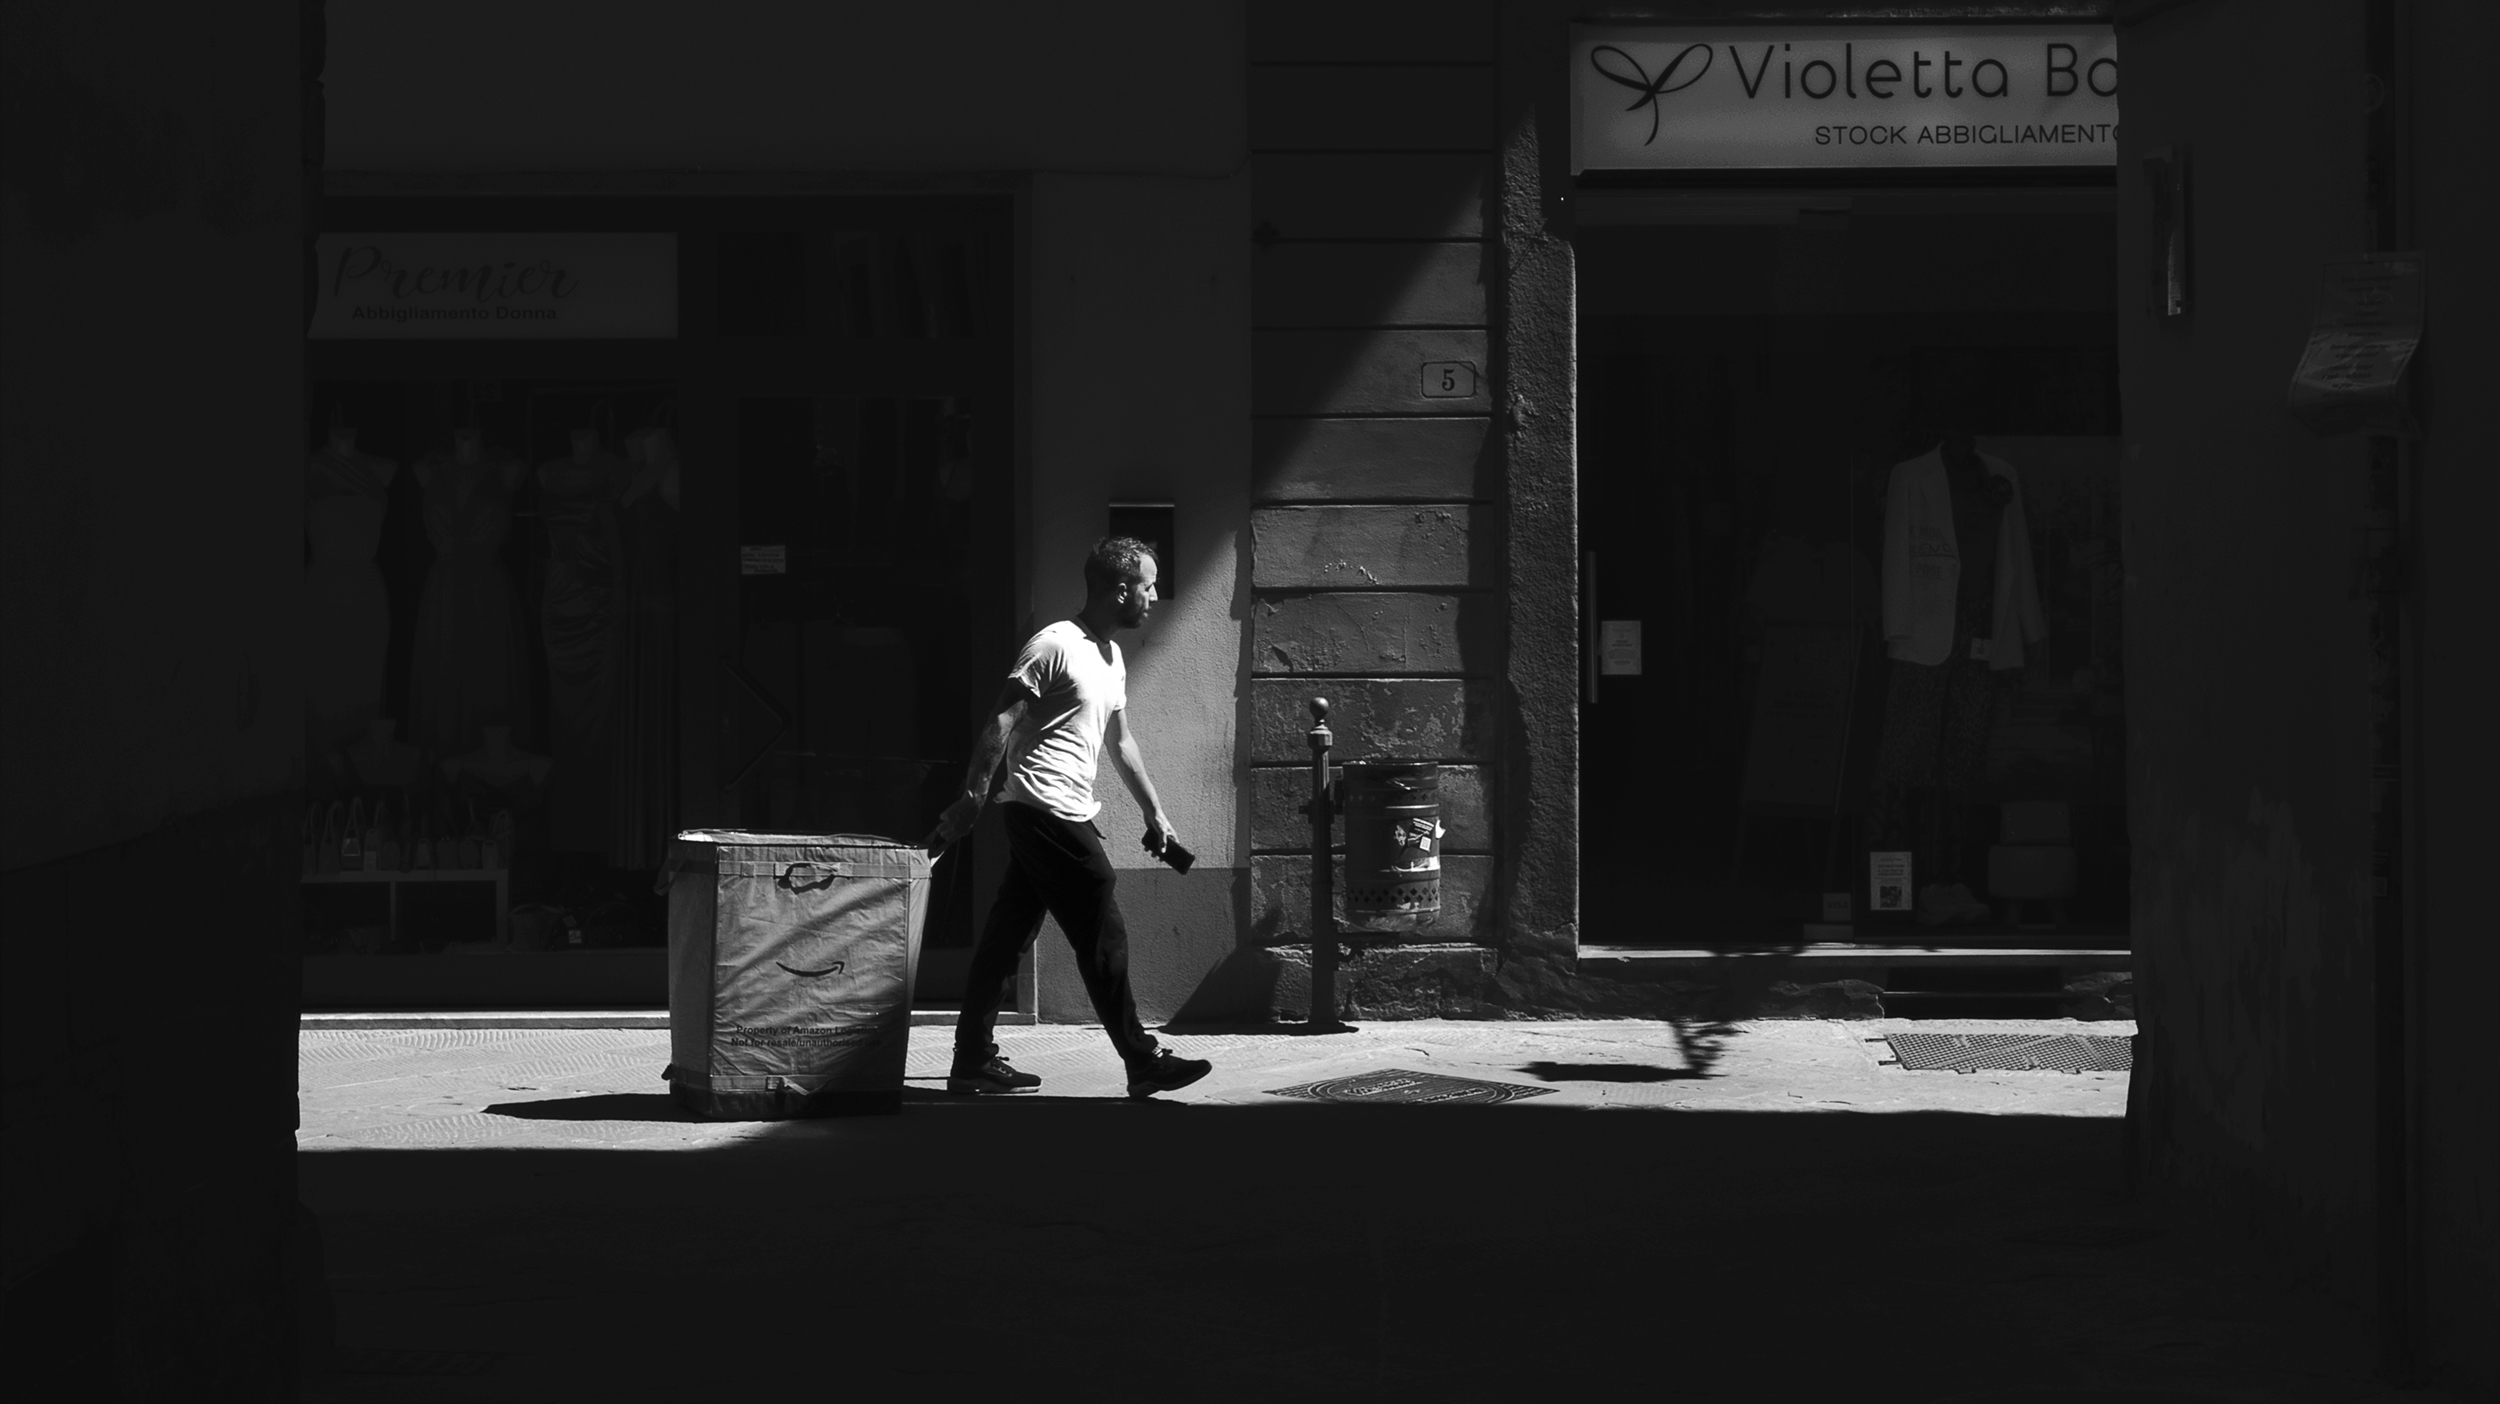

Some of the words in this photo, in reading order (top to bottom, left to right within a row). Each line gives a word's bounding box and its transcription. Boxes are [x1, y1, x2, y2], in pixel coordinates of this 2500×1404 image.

[1729, 43, 2009, 99] Violetta
[1815, 125, 1907, 145] STOCK
[1917, 124, 2118, 145] ABBIGLIAMENT
[333, 245, 580, 303] Premier
[352, 306, 489, 323] Abbigliamento
[496, 307, 557, 320] Donna
[1442, 368, 1455, 392] 5
[1826, 900, 1848, 909] VISA
[736, 1026, 778, 1036] Property
[781, 1026, 791, 1035] of
[792, 1026, 832, 1035] Amazon
[731, 1038, 748, 1047] Not
[751, 1038, 764, 1047] for
